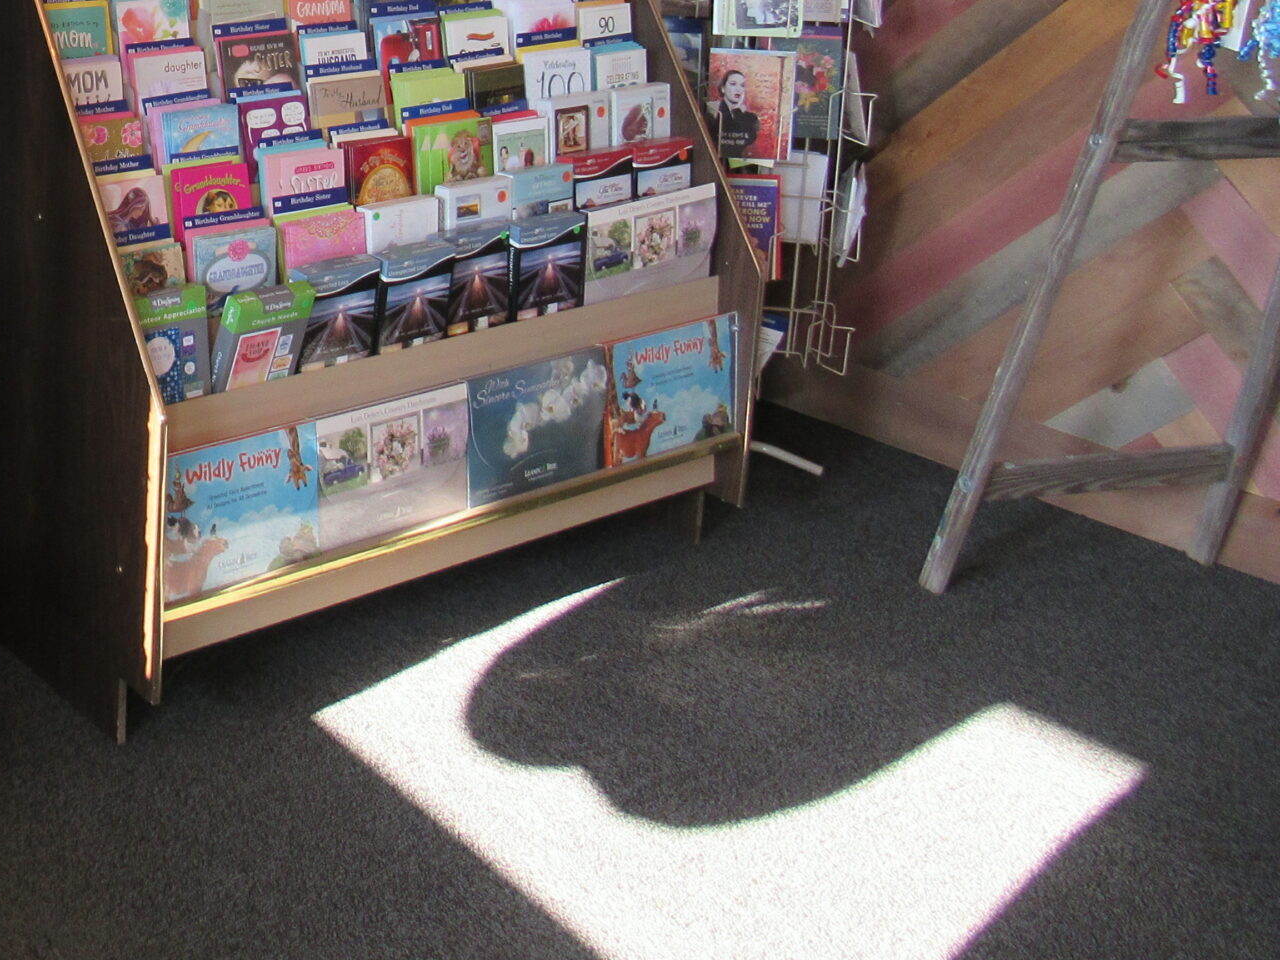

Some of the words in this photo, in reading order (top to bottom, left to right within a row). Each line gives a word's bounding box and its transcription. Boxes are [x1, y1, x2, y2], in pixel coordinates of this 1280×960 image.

[296, 0, 345, 17] GRANDMA
[599, 16, 615, 34] 90
[164, 60, 202, 74] daughter
[254, 51, 293, 72] SISTER
[543, 60, 576, 70] Celebrating
[70, 70, 109, 94] MOM
[536, 72, 585, 100] 100
[342, 83, 382, 109] Husband
[419, 106, 439, 114] Birthday
[94, 163, 119, 172] Birthday
[120, 161, 140, 169] Mother
[290, 196, 313, 205] Birthday
[315, 194, 331, 202] Sister
[195, 217, 219, 226] Birthday
[219, 211, 260, 223] Granddaughter
[164, 306, 206, 320] Appreciation
[252, 315, 275, 326] Church
[278, 311, 298, 320] Needs
[635, 344, 670, 366] Wildly
[673, 337, 705, 356] Funny
[184, 457, 235, 485] Wildly
[238, 448, 282, 473] Funny
